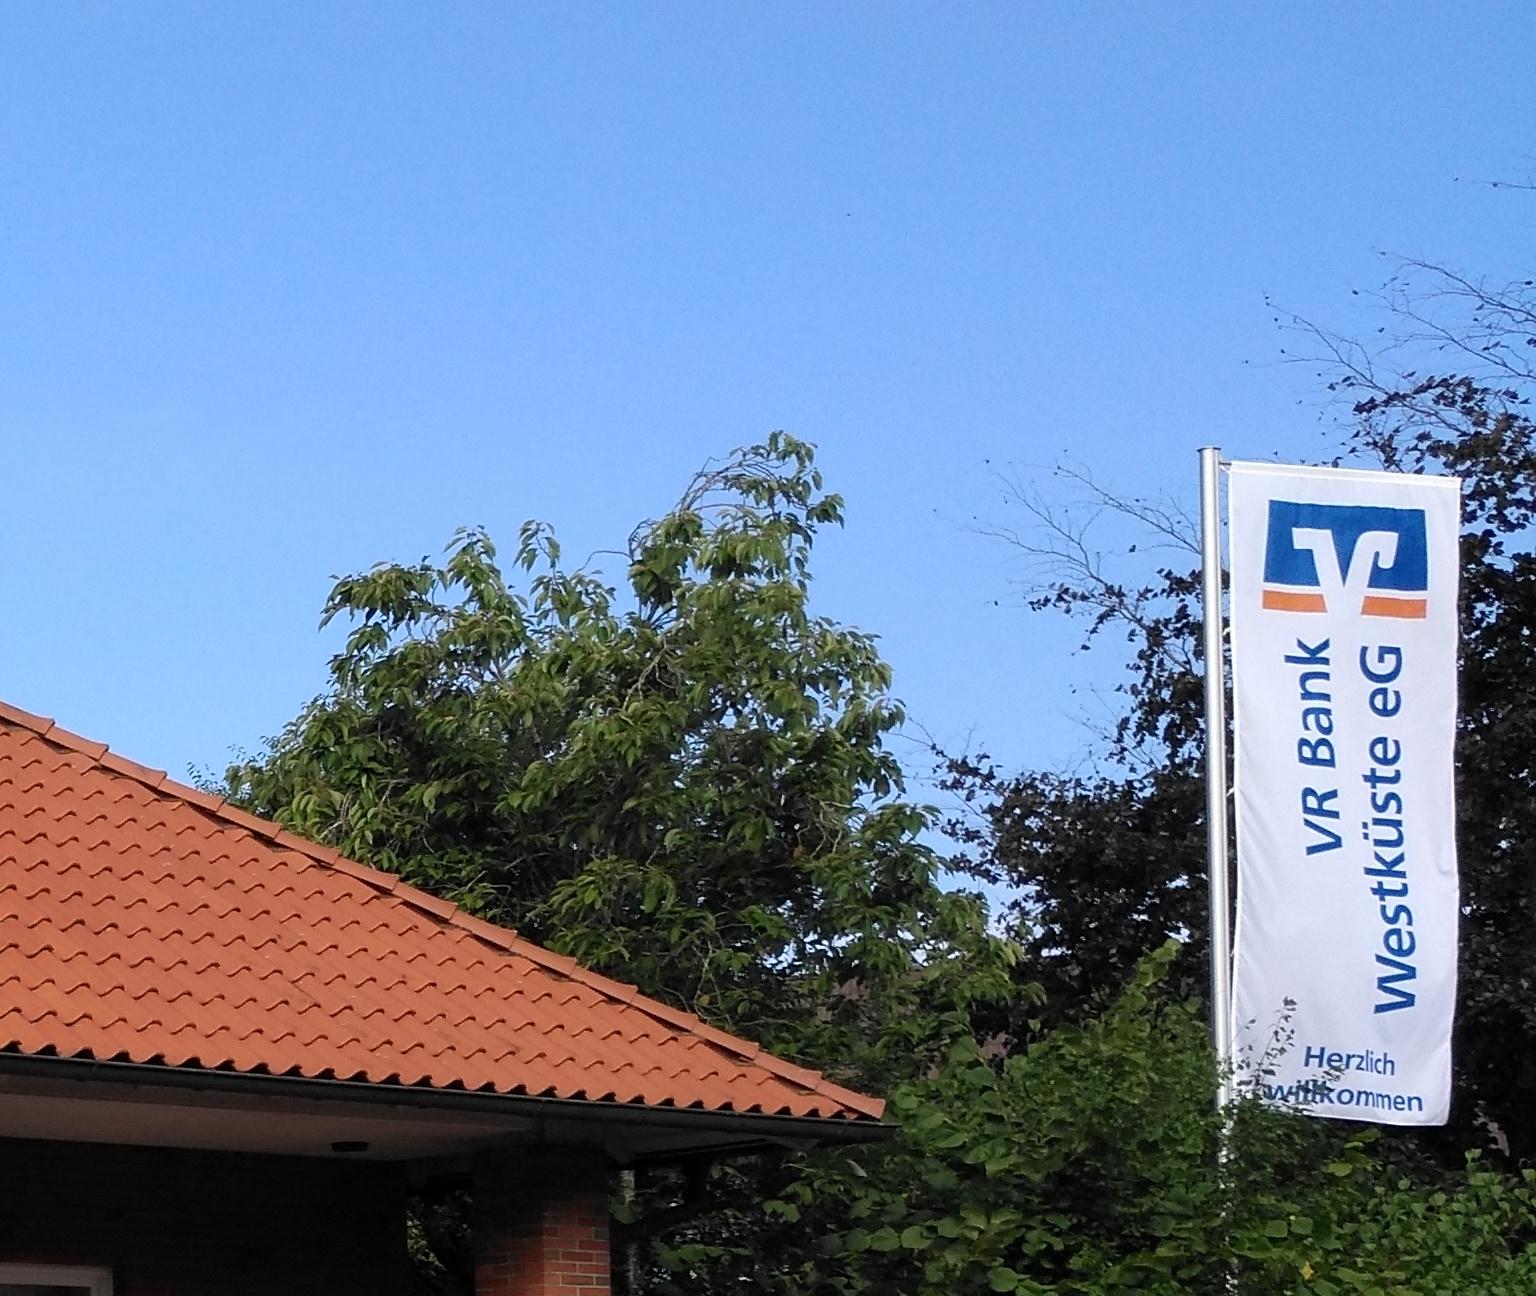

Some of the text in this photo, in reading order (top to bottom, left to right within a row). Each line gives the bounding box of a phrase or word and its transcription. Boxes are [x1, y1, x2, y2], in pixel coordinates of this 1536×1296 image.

[1283, 636, 1344, 858] VR Bank
[1359, 644, 1416, 1016] Westküste eG
[1263, 1078, 1424, 1112] willkommen
[1303, 1045, 1396, 1077] Herzlich
